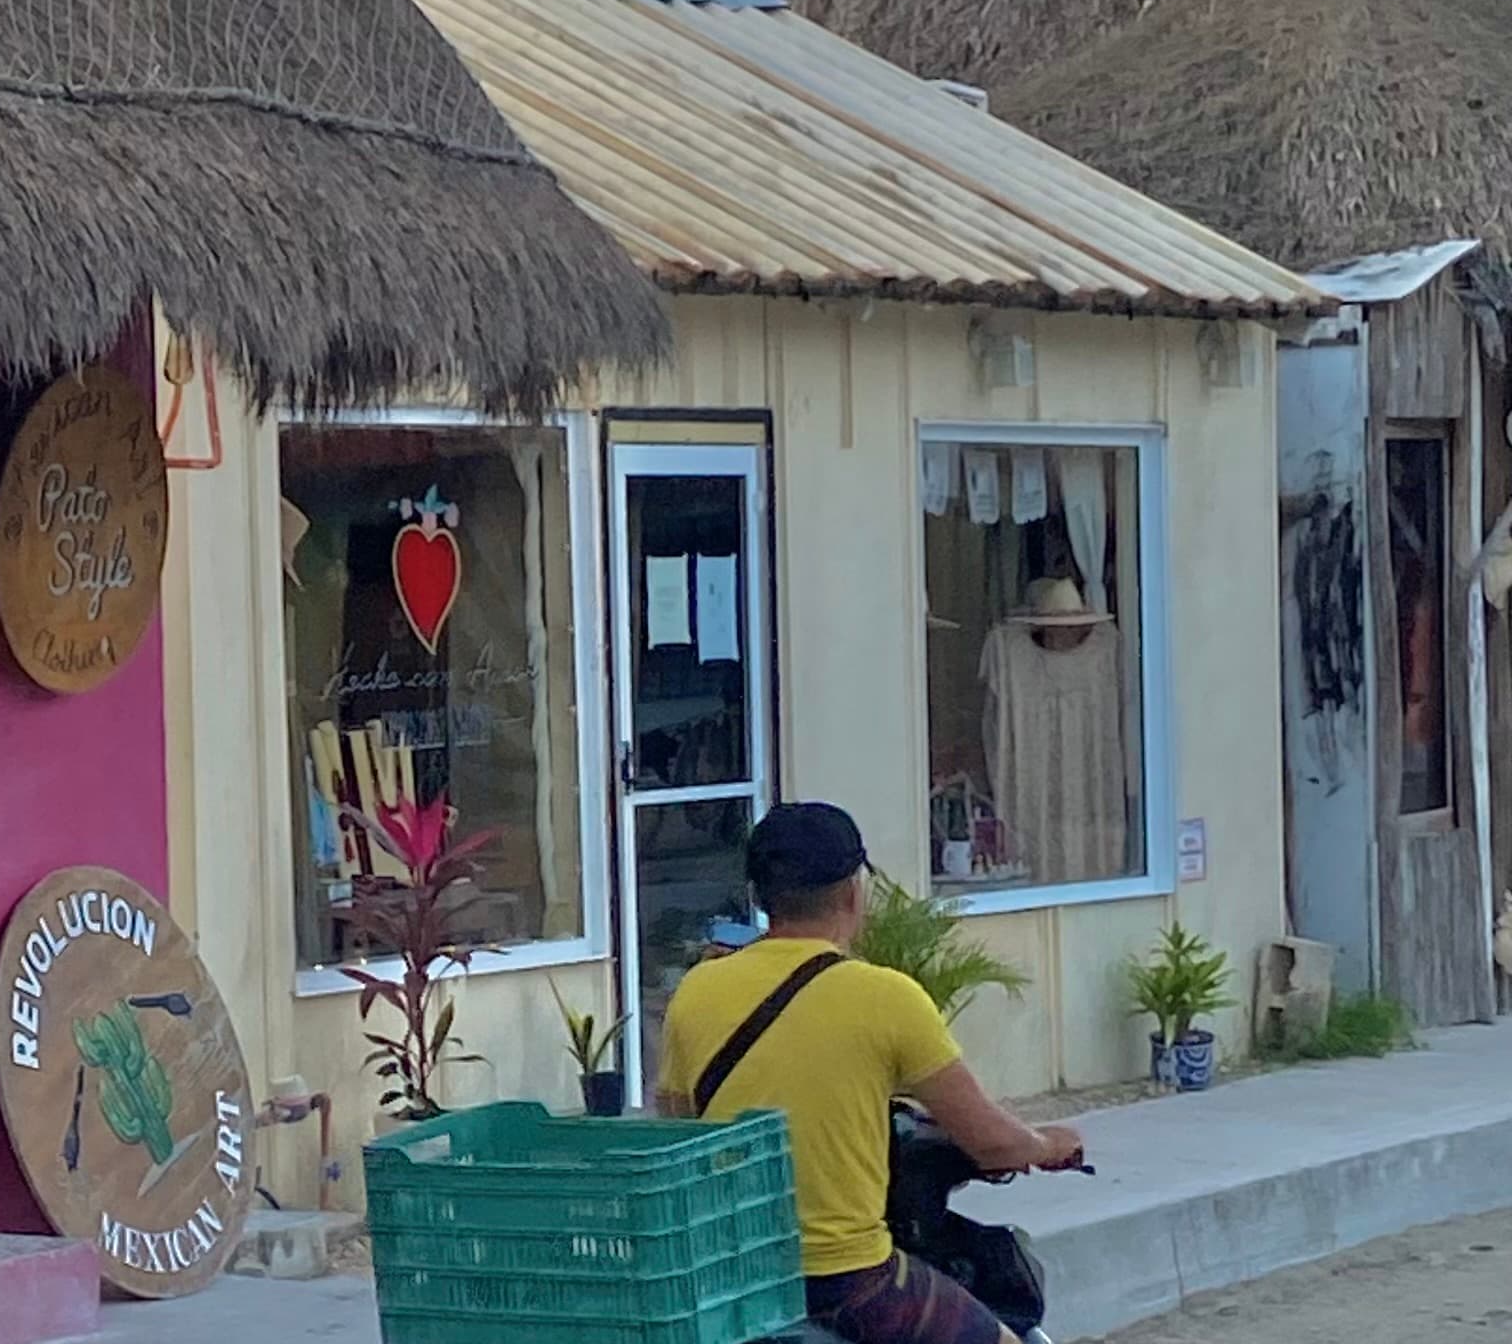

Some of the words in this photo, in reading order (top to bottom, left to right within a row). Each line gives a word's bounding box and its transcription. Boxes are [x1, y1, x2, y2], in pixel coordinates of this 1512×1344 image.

[39, 463, 111, 532] Pato
[49, 530, 133, 620] Style
[12, 890, 157, 1069] REVOLUCION
[97, 1198, 224, 1273] MEXICAN
[214, 1089, 242, 1197] ART
